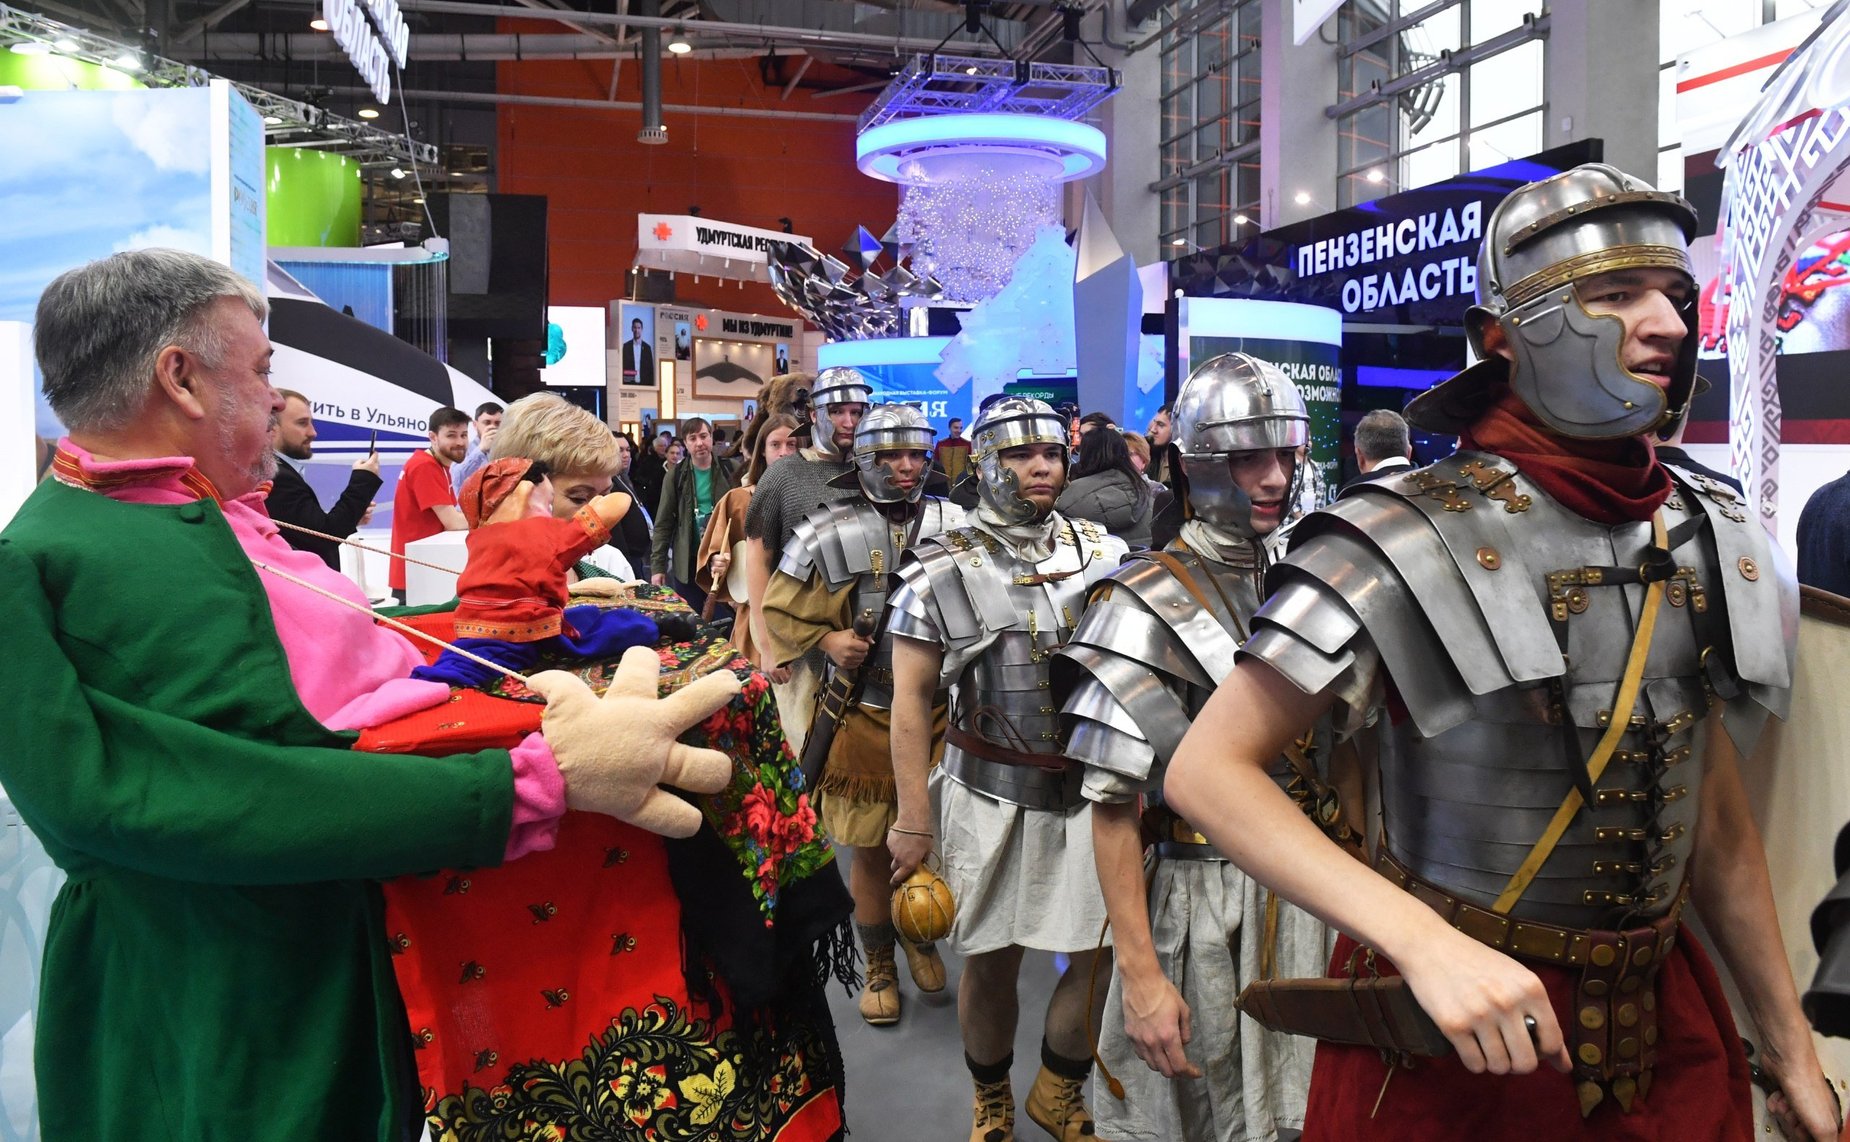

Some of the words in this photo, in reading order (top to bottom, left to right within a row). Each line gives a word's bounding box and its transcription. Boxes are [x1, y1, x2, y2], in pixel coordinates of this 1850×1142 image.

[367, 0, 410, 70] СКАЯ
[696, 226, 753, 250] УДМУРТСКАЯ
[1298, 200, 1482, 278] ПЕНЗЕНСКАЯ
[1342, 256, 1478, 313] ОБЛАСТЬ
[722, 318, 737, 333] МЫ
[739, 320, 749, 334] ИЗ
[750, 321, 793, 338] УДМУРТИИ!
[309, 401, 345, 417] ить
[351, 408, 360, 420] в
[366, 407, 427, 431] Ульяно
